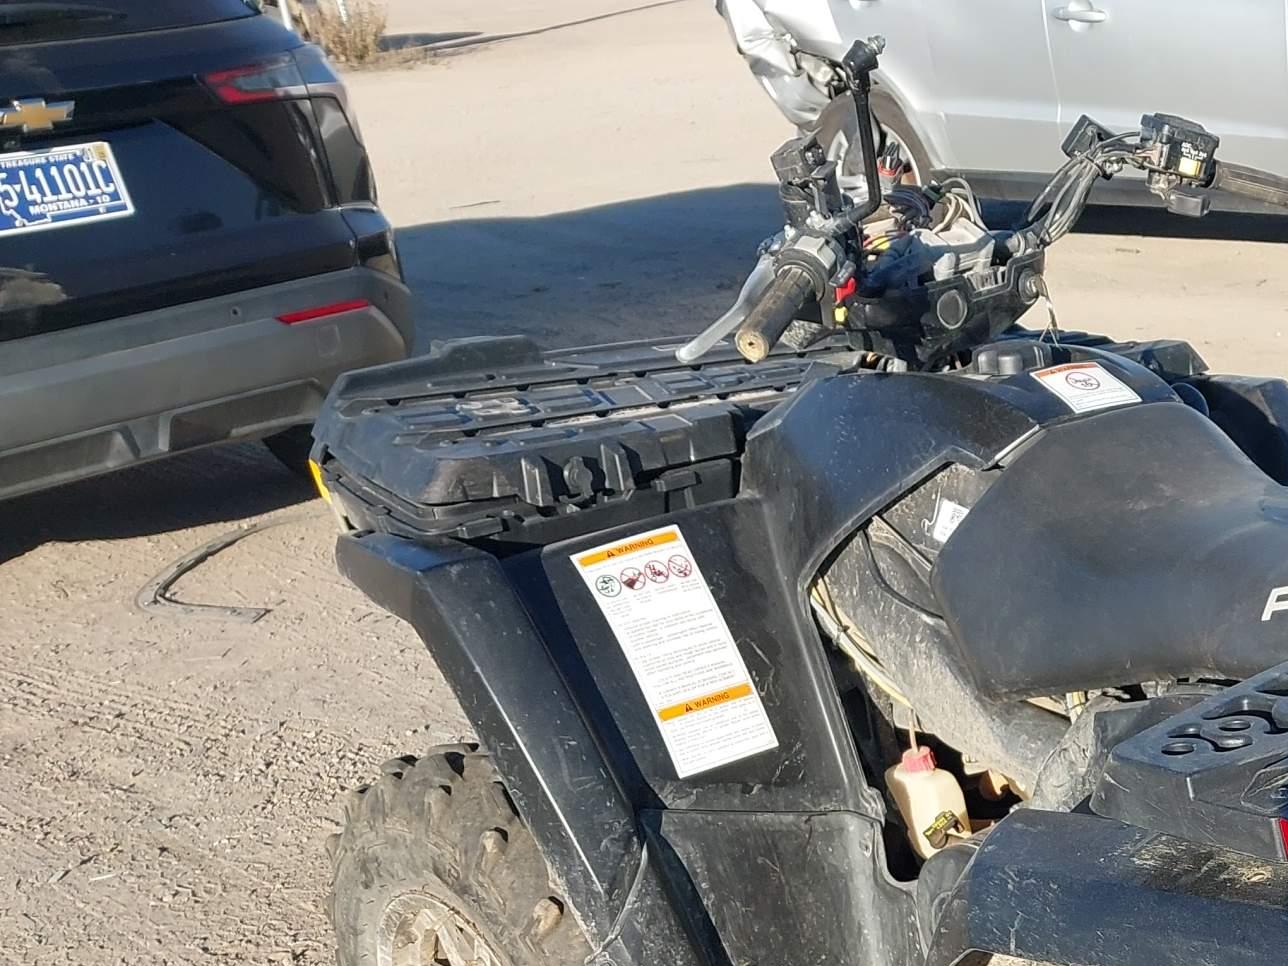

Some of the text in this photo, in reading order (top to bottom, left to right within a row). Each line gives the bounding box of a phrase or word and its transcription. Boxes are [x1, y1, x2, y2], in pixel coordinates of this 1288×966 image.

[29, 199, 88, 216] MONTANA
[616, 537, 654, 554] WARNING
[694, 691, 730, 708] WARNING
